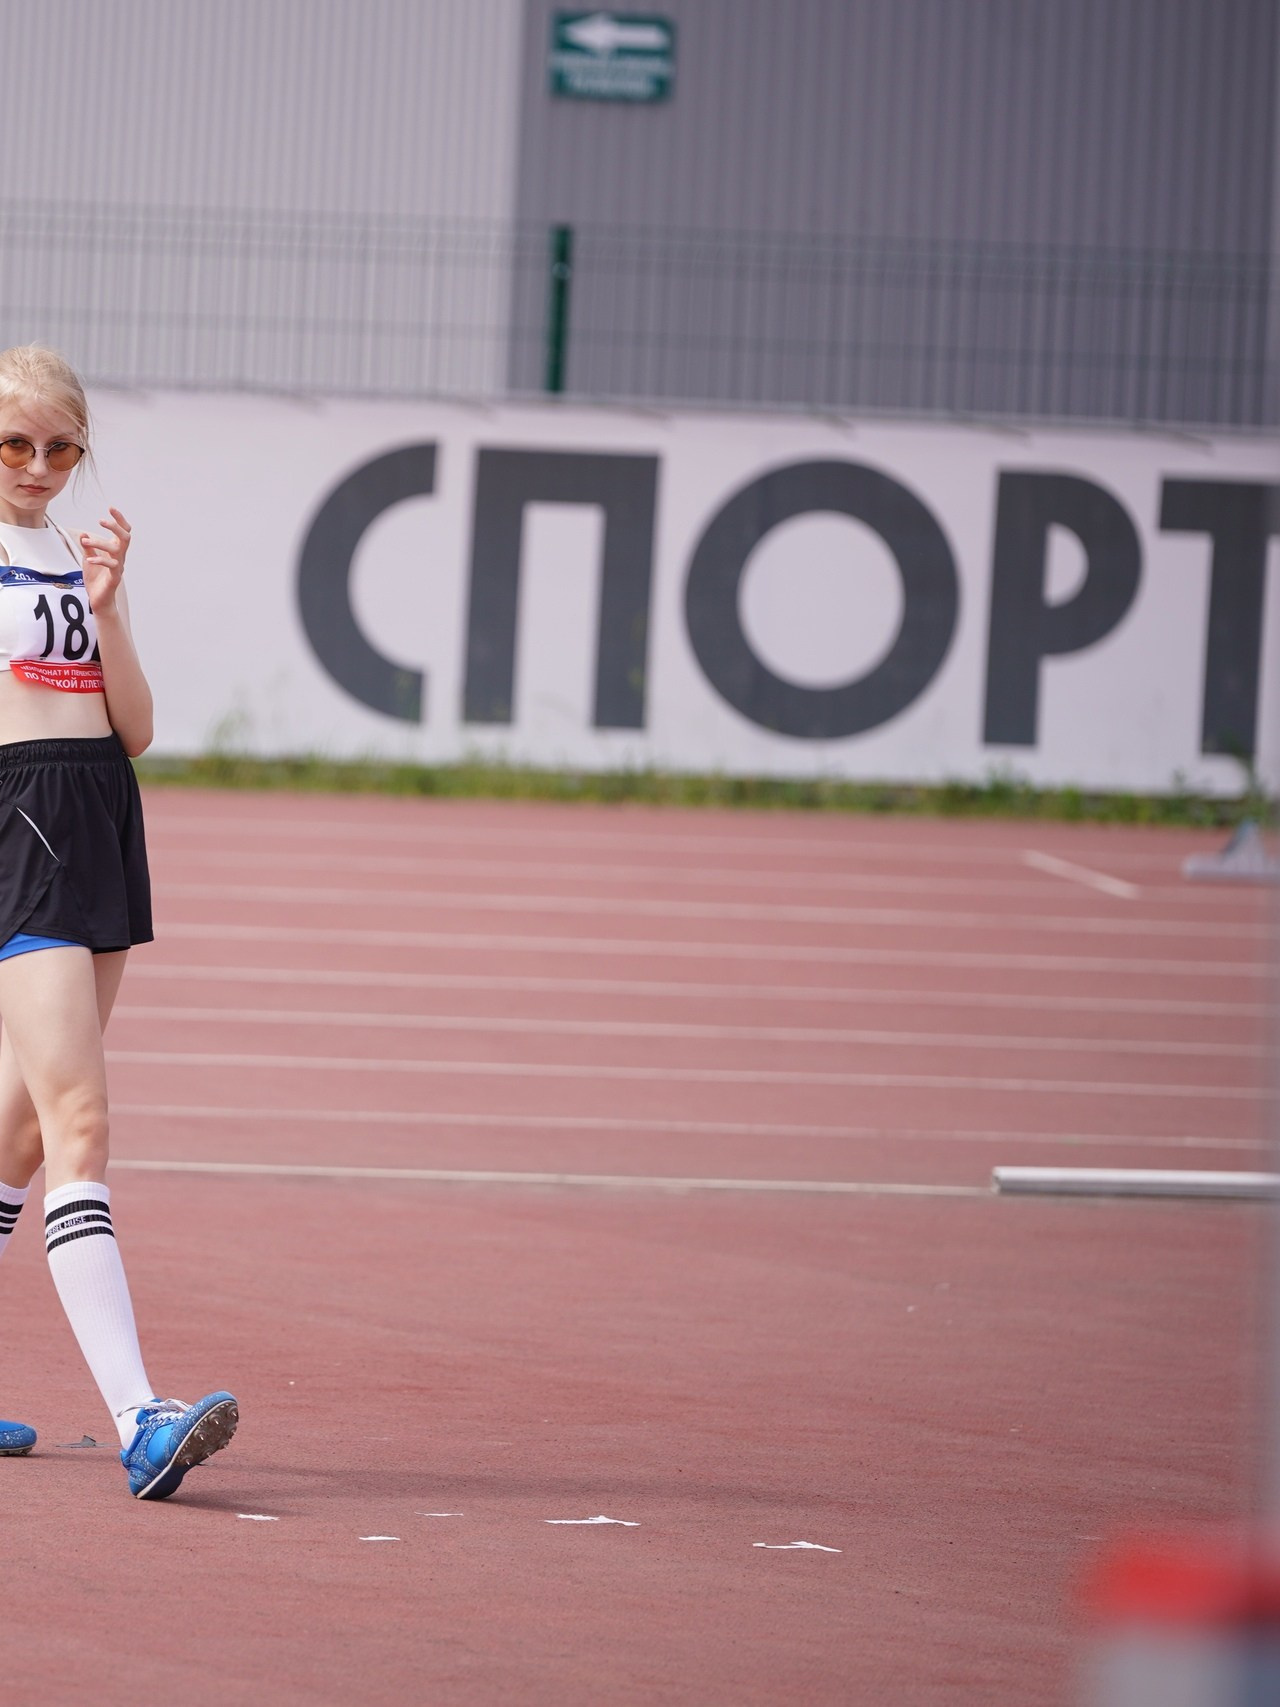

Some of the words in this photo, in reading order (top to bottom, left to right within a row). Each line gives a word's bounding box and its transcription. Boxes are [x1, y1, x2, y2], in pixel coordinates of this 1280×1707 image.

[34, 594, 101, 662] 18
[294, 438, 1280, 756] СПОРТ
[24, 672, 39, 681] ПО
